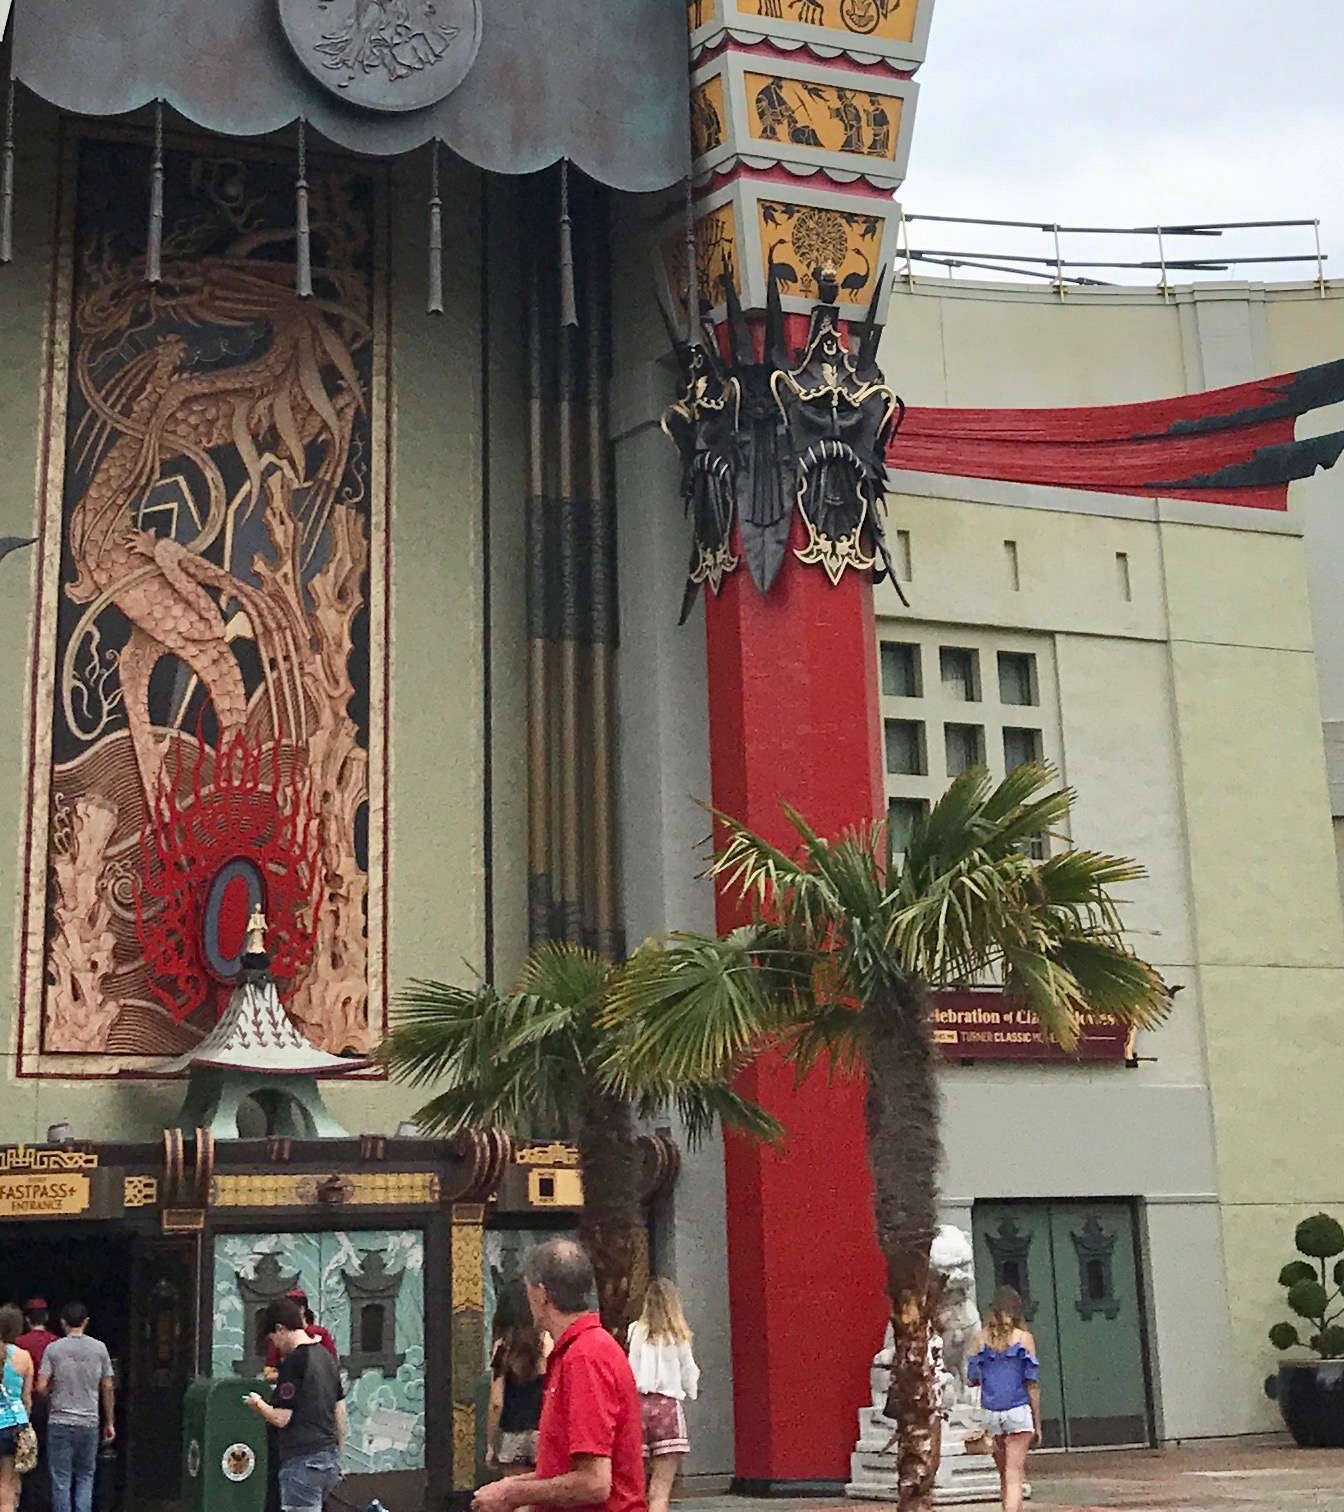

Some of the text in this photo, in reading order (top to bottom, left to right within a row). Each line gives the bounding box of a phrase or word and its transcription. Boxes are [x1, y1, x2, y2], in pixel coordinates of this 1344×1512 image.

[927, 1008, 1001, 1024] elebration
[994, 1032, 1032, 1043] CLASSIC
[11, 1198, 63, 1211] ENTRANCE
